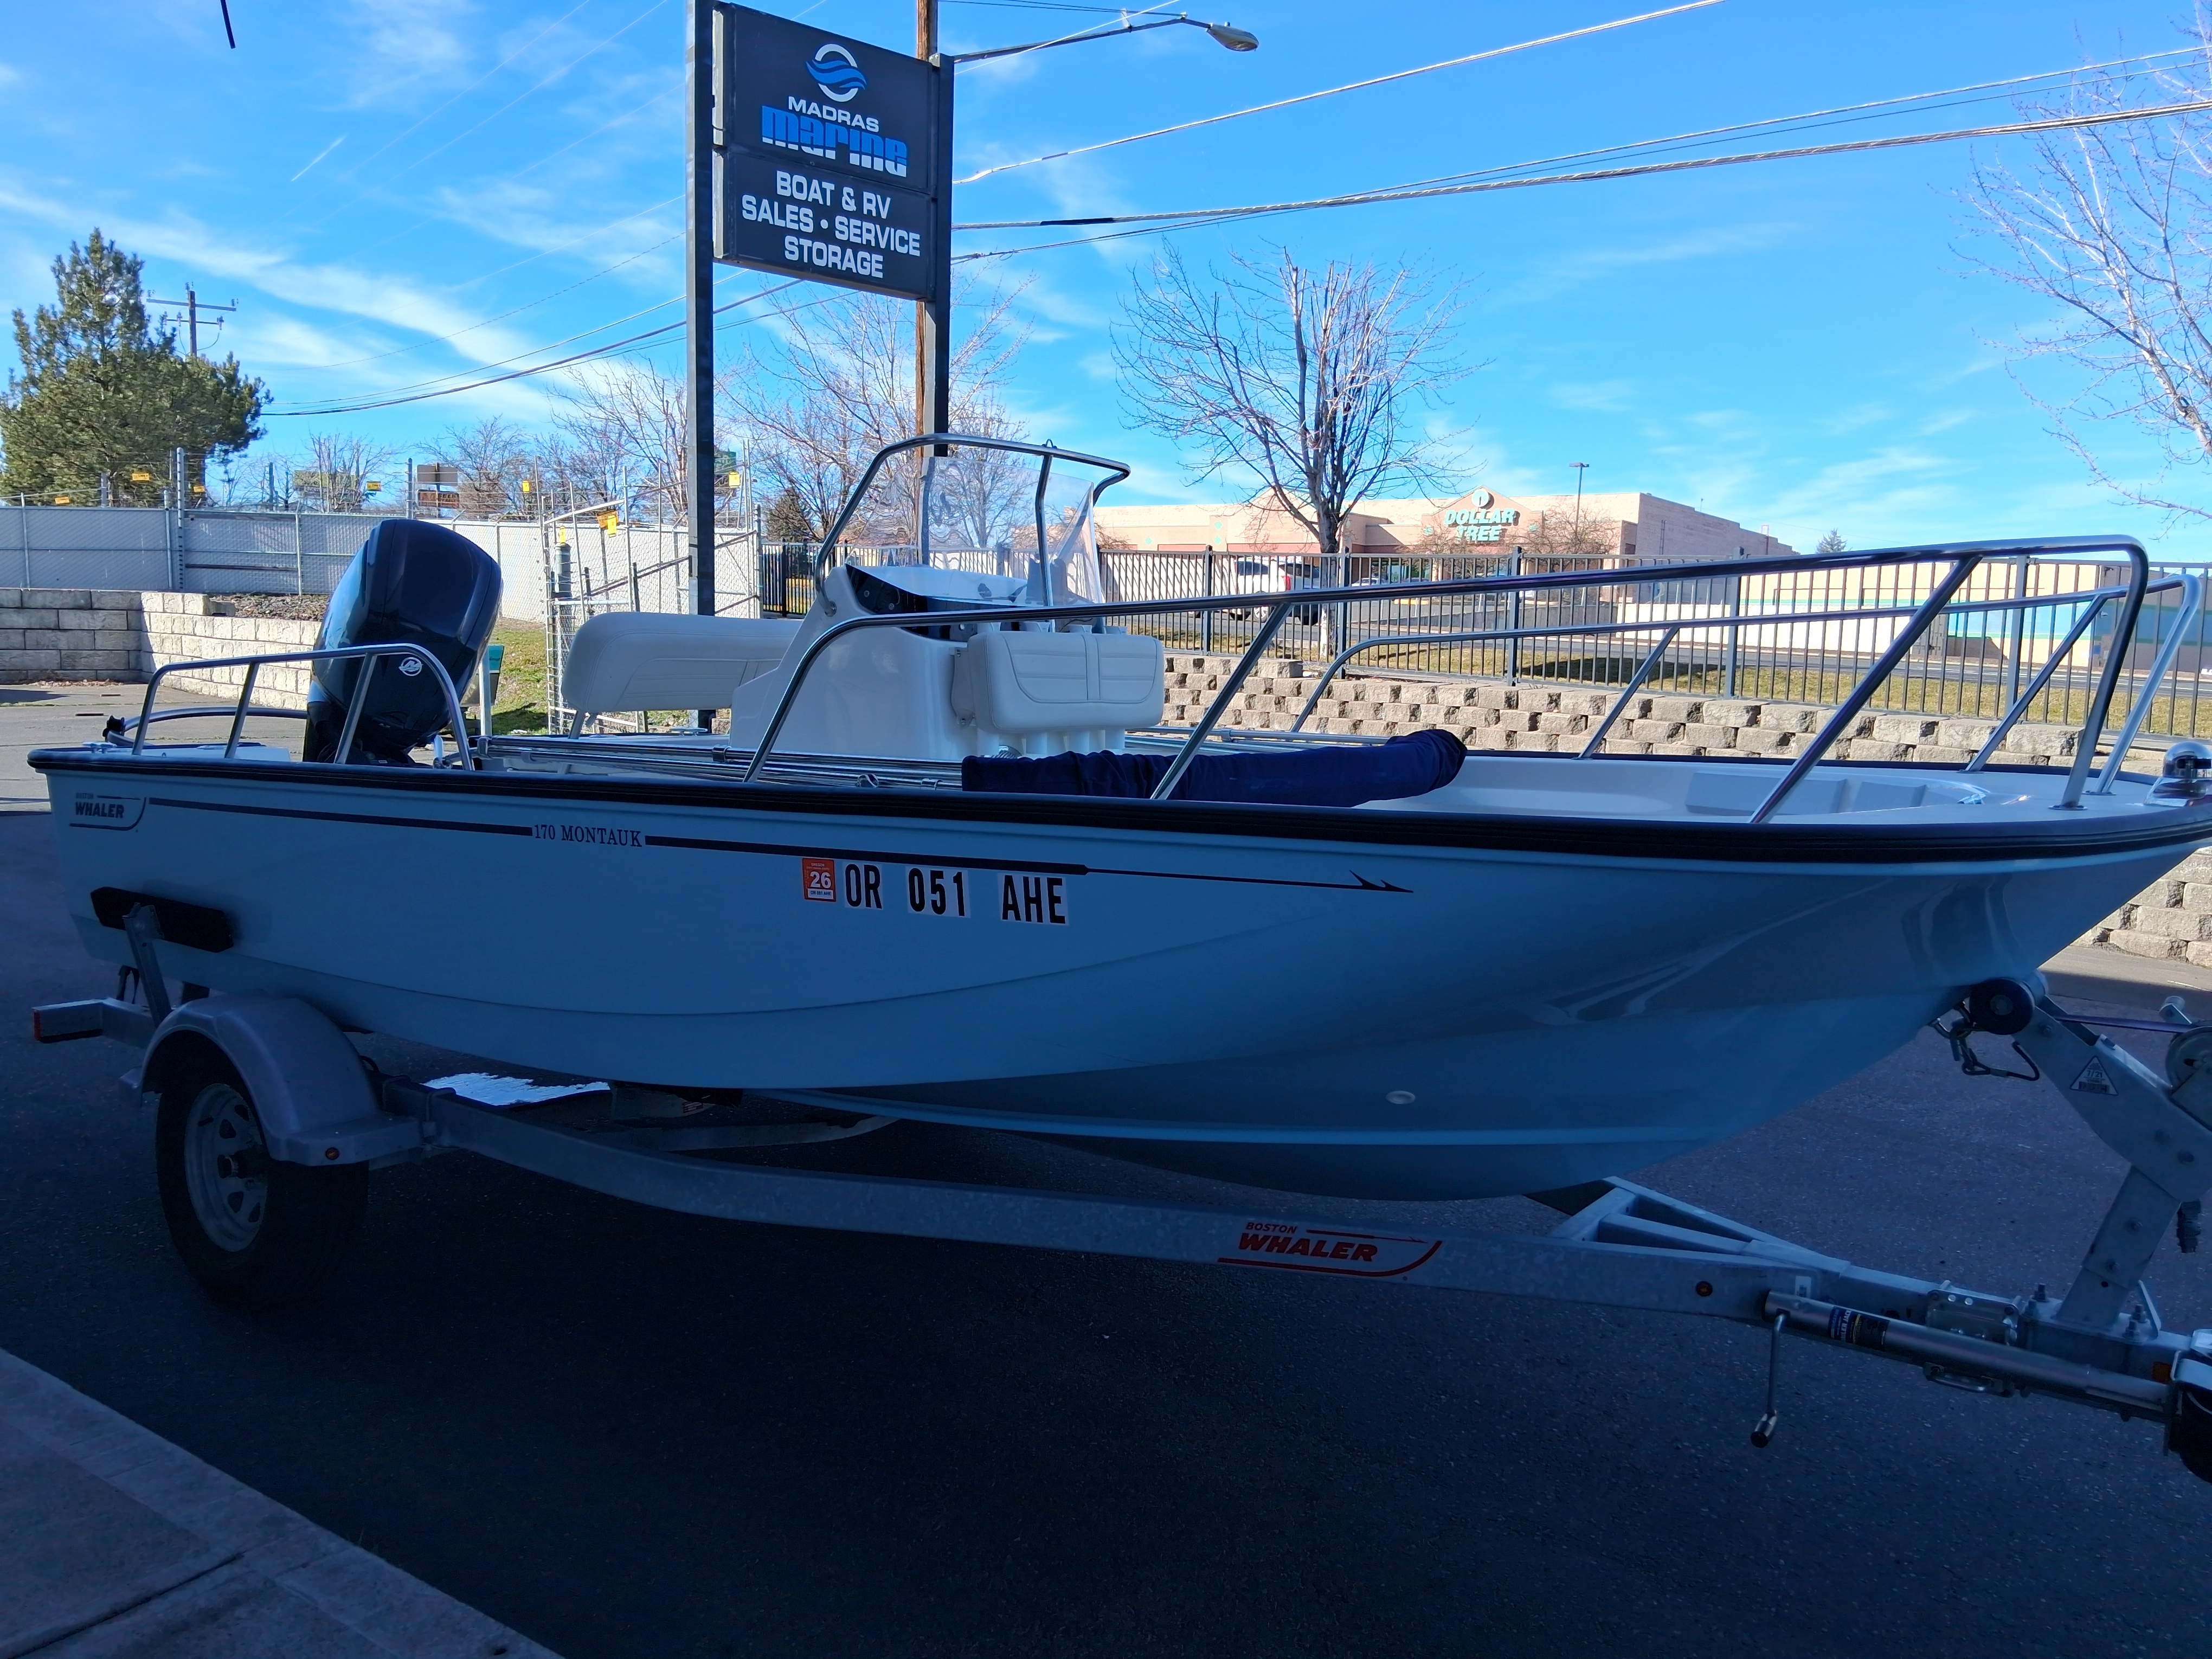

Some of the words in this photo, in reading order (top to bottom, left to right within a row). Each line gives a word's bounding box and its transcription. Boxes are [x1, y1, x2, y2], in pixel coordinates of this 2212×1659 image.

[788, 96, 879, 133] MADRAS
[762, 106, 908, 178] marine
[776, 171, 835, 206] BOAT
[841, 187, 857, 212] &
[863, 191, 891, 219] RV
[742, 195, 814, 233] SALES
[835, 216, 921, 257] SERVICE
[785, 235, 884, 278] STORAGE
[1444, 508, 1516, 525] DOLLAR
[1457, 524, 1502, 542] TREE
[75, 801, 124, 818] WHALER
[535, 824, 556, 840] 170
[561, 825, 642, 847] MONTAUK
[810, 871, 831, 889] 26
[845, 864, 882, 909] OR
[908, 867, 966, 917] 051
[1002, 874, 1066, 924] AHE
[1245, 1221, 1297, 1233] BOSTON
[1238, 1232, 1378, 1262] WHALER
